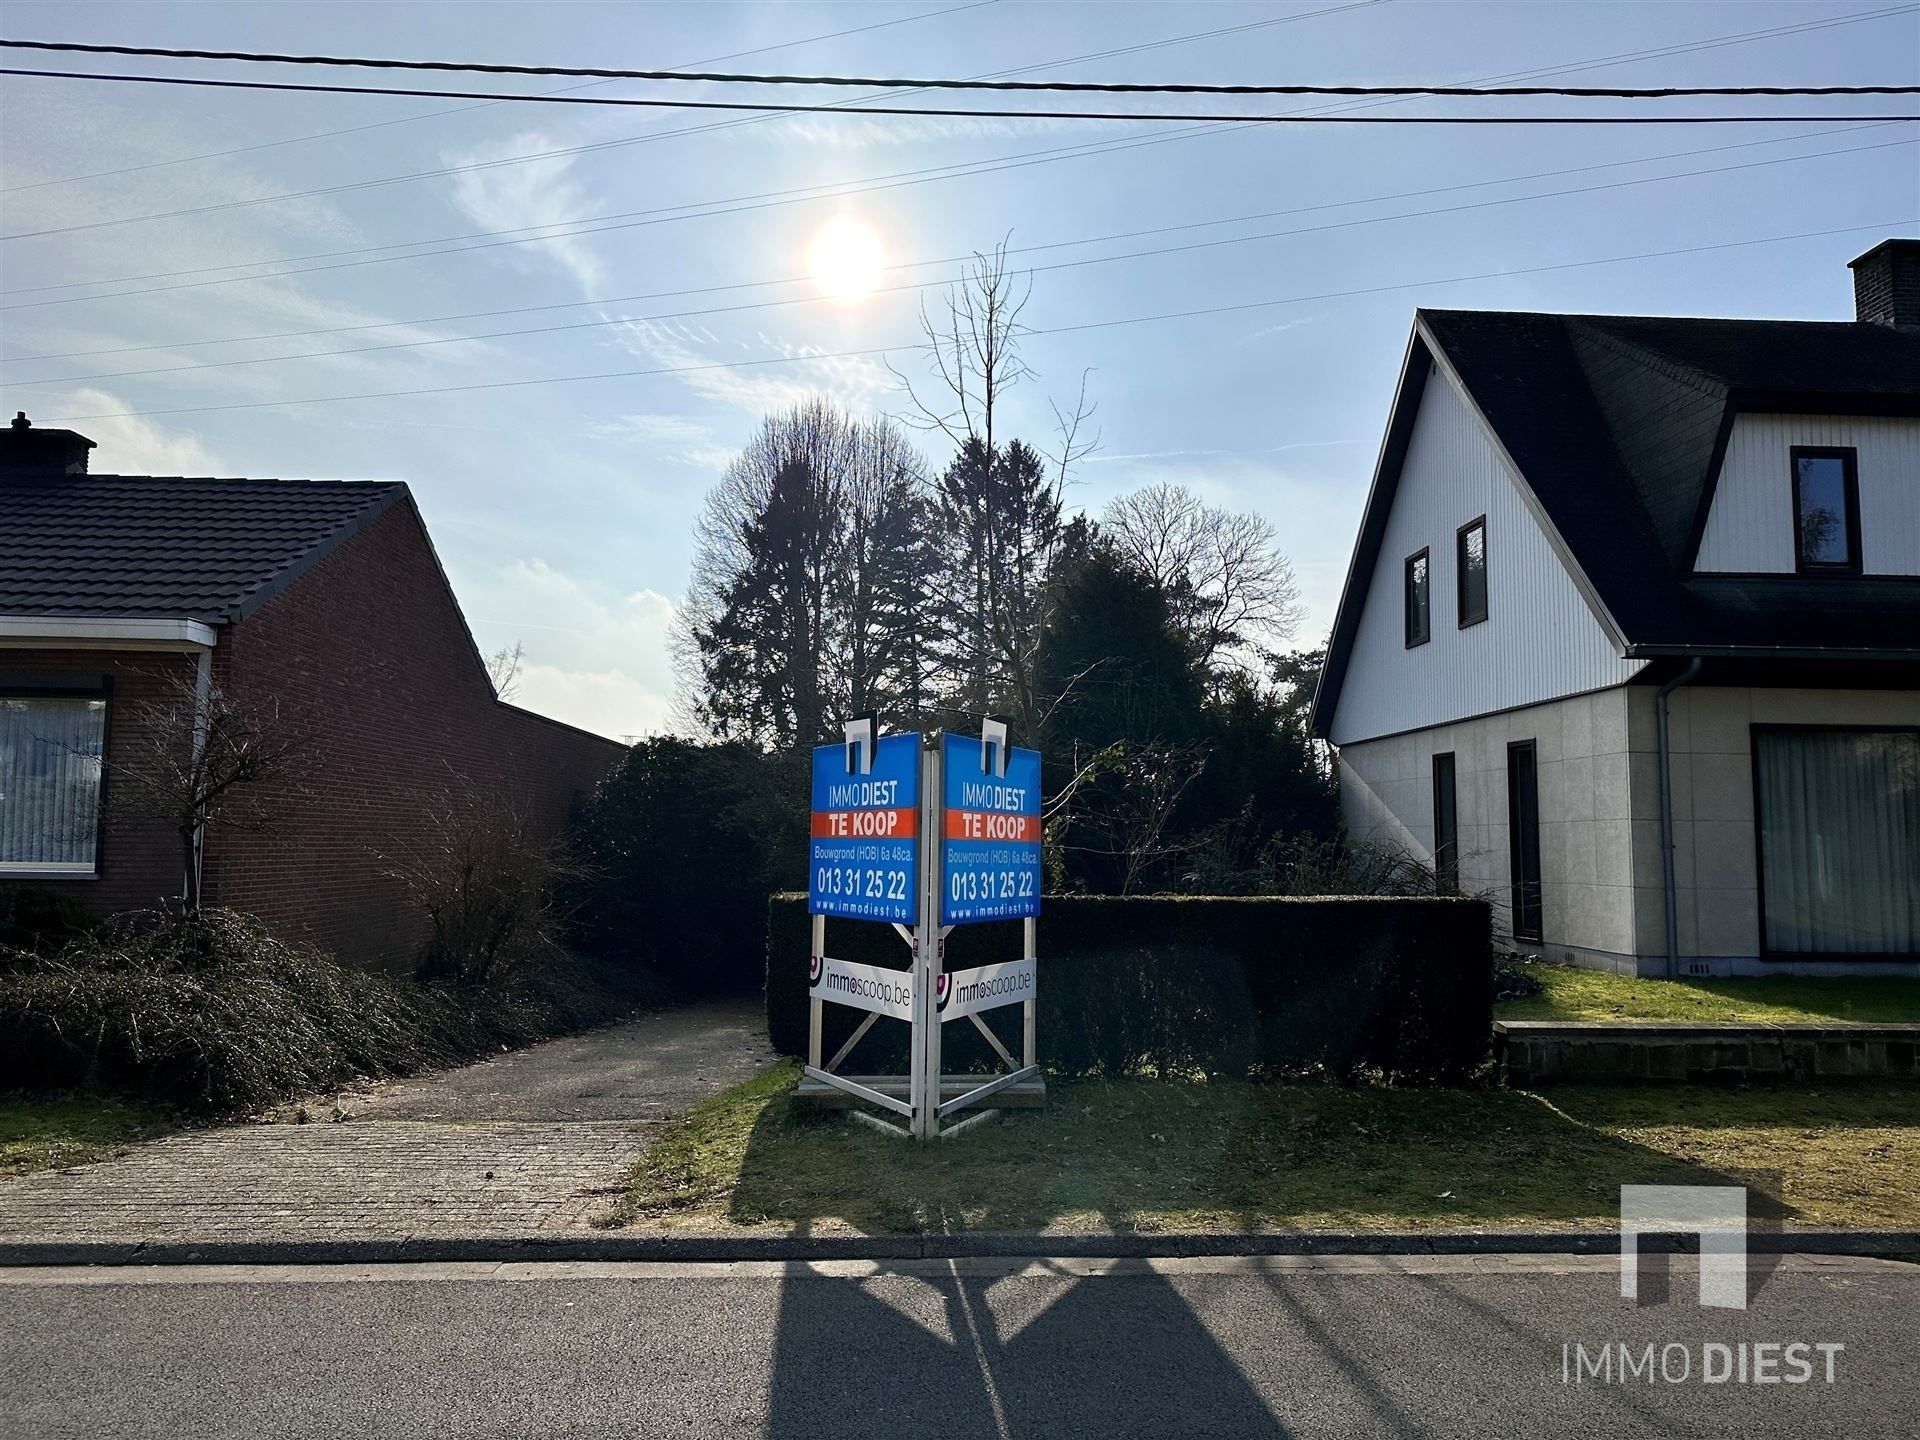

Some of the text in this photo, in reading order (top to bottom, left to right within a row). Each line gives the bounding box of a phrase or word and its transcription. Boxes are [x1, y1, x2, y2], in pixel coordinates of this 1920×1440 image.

[829, 811, 898, 836] TE KOOP
[962, 813, 1026, 839] TE KOOP
[815, 845, 913, 864] Bouwgrond (HOB) 6a 48ca.
[947, 848, 989, 867] Bouwgrond
[990, 849, 1011, 867] (HOB)
[818, 867, 906, 900] 013 31 25 22
[952, 871, 1033, 901] 013 31 25 22
[816, 900, 907, 919] www.immodiest.be
[950, 902, 1034, 919] www.immodiest.be
[827, 966, 910, 1007] immoscoop.be
[956, 970, 1031, 1004] immoscoop.be
